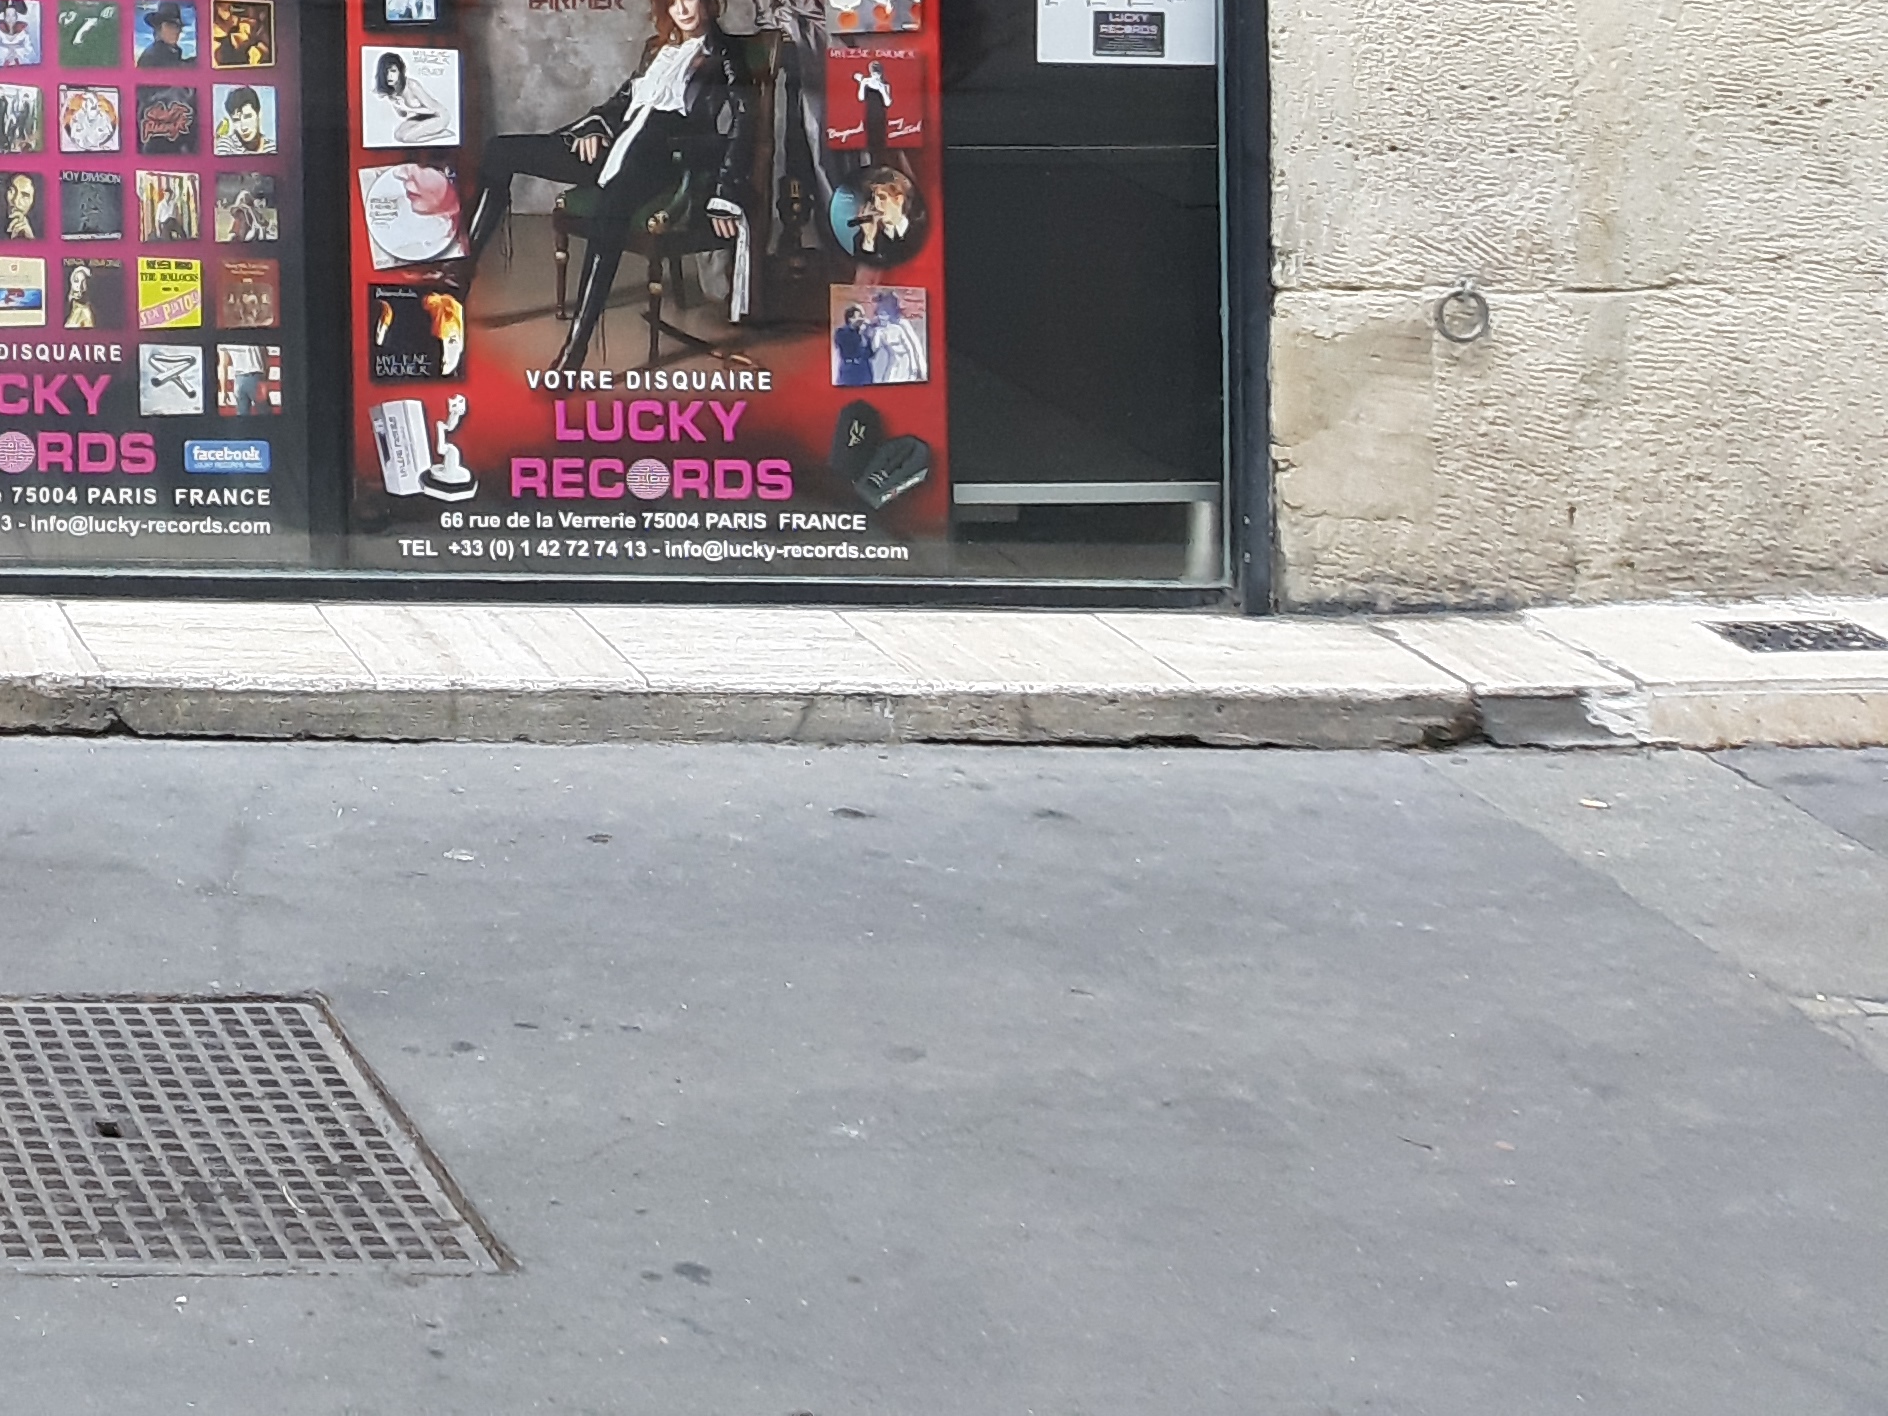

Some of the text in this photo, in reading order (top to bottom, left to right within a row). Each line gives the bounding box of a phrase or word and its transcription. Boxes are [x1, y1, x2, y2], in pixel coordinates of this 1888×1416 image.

[526, 370, 771, 390] VOTRE DISQUAIRE
[547, 400, 746, 442] LUCKY
[193, 446, 260, 460] facebook
[511, 457, 793, 500] RECORDS
